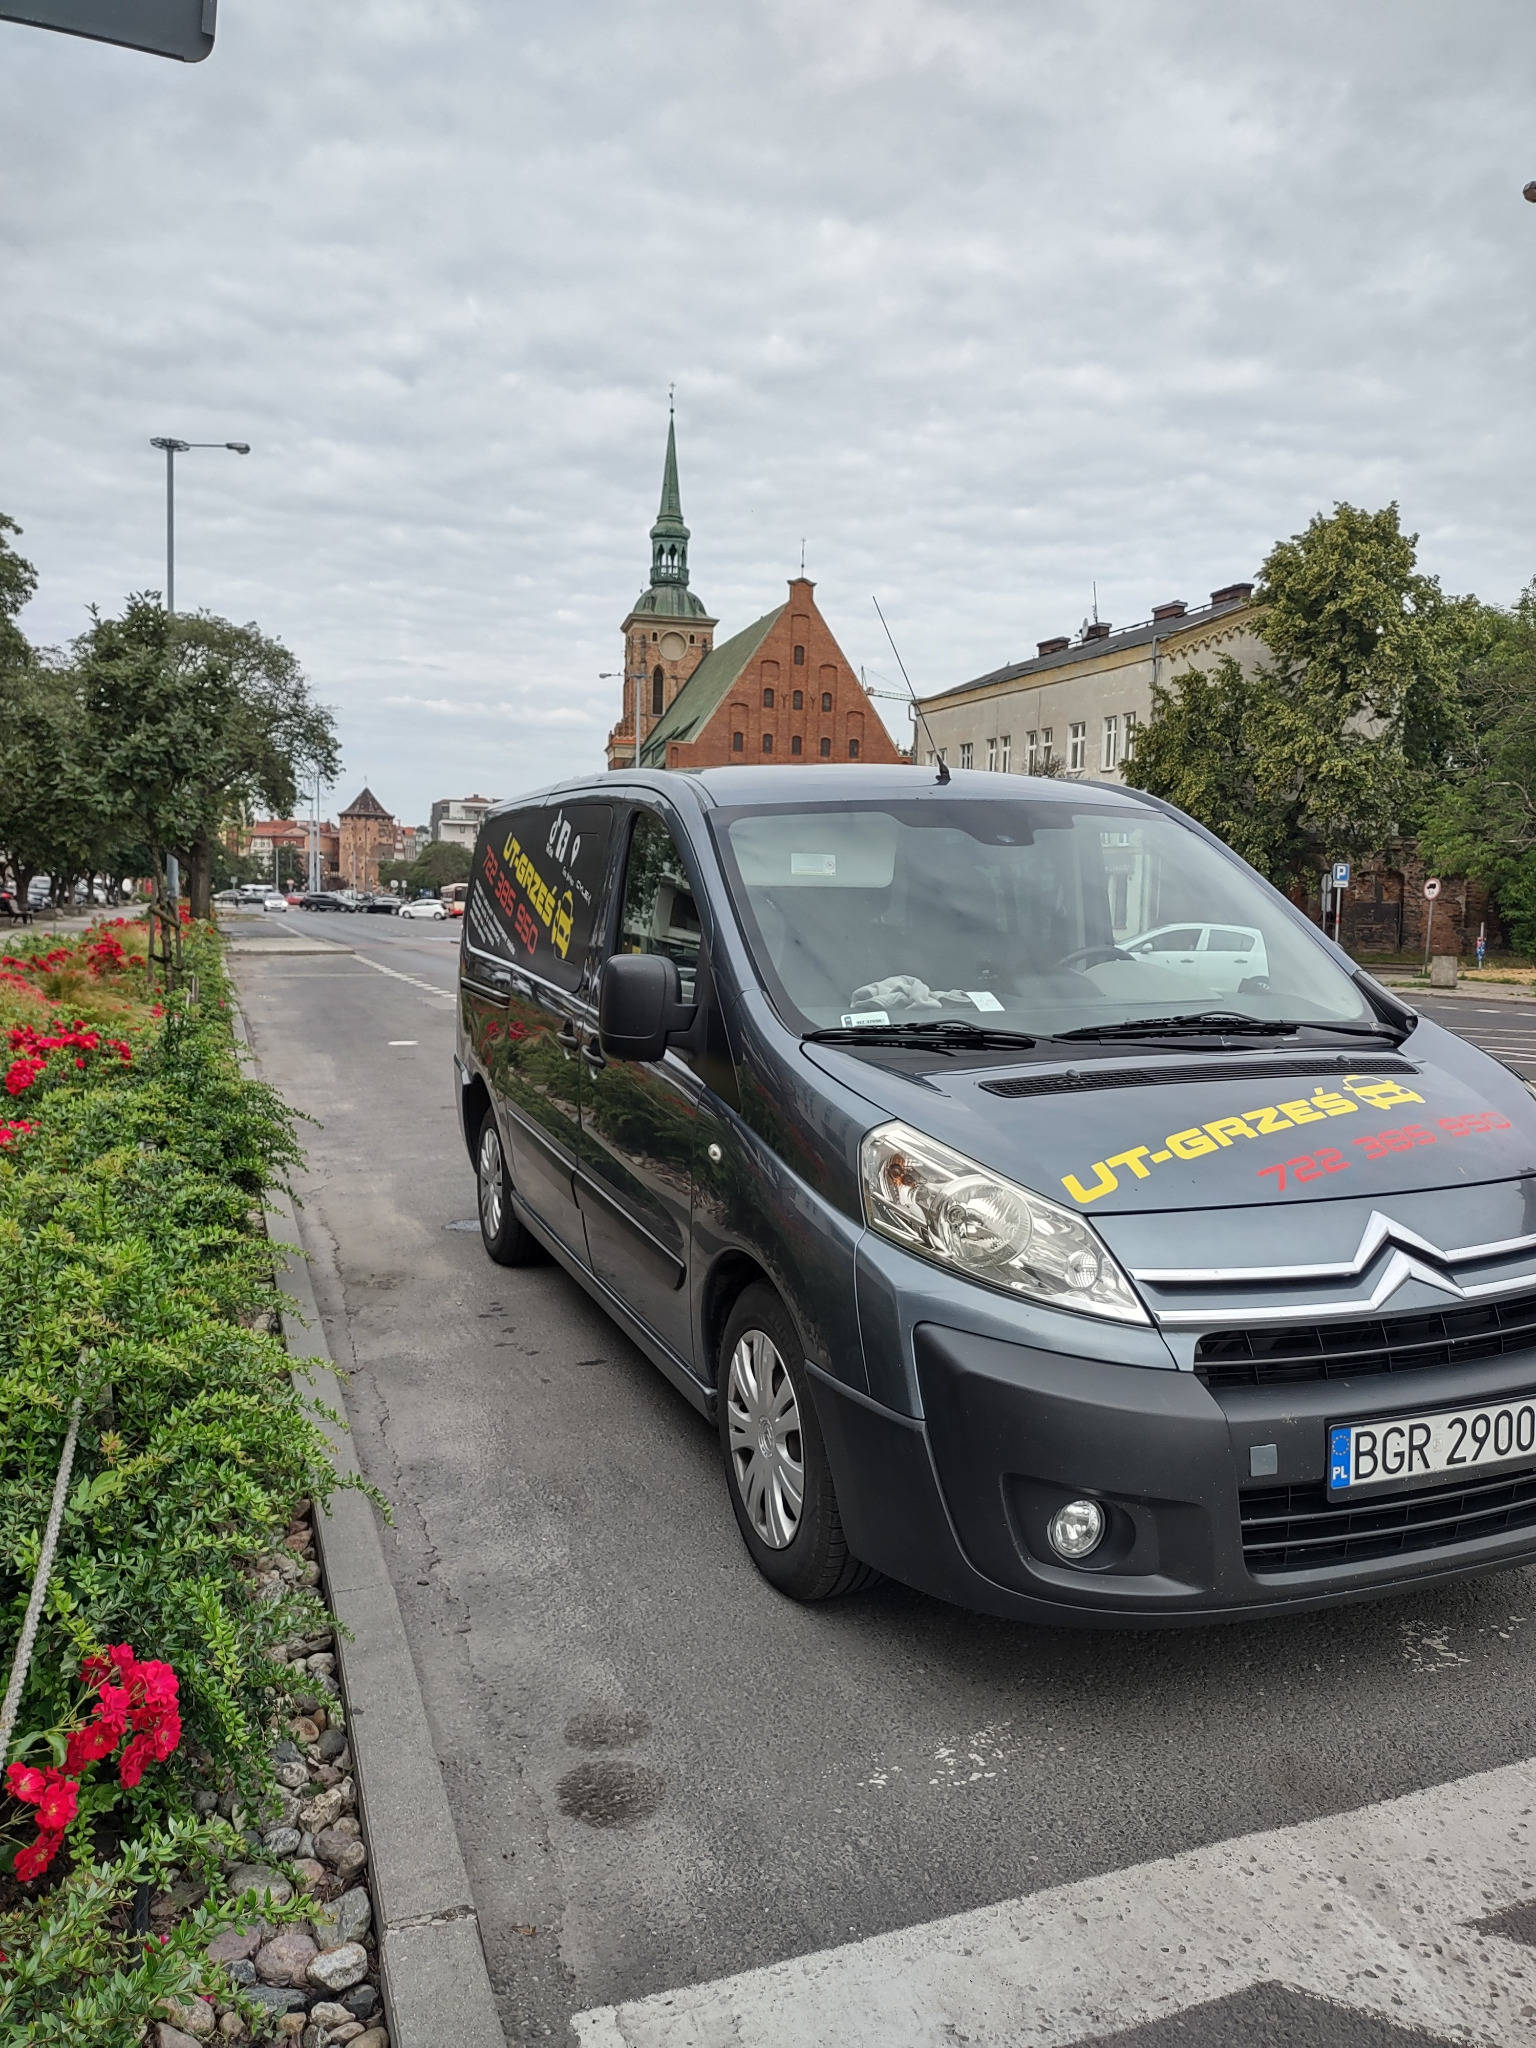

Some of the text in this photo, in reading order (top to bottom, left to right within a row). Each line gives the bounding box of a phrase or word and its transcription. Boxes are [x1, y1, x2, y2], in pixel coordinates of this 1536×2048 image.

[483, 844, 498, 886] 722
[495, 870, 516, 917] 385
[515, 903, 538, 955] 950
[503, 831, 557, 927] UT-GRZEŚ
[1337, 866, 1346, 879] P
[1060, 1087, 1359, 1204] UT-GRZEŚ
[1257, 1111, 1511, 1191] 722 385 950
[1332, 1465, 1348, 1480] PL
[1354, 1404, 1535, 1481] BGR 2900
